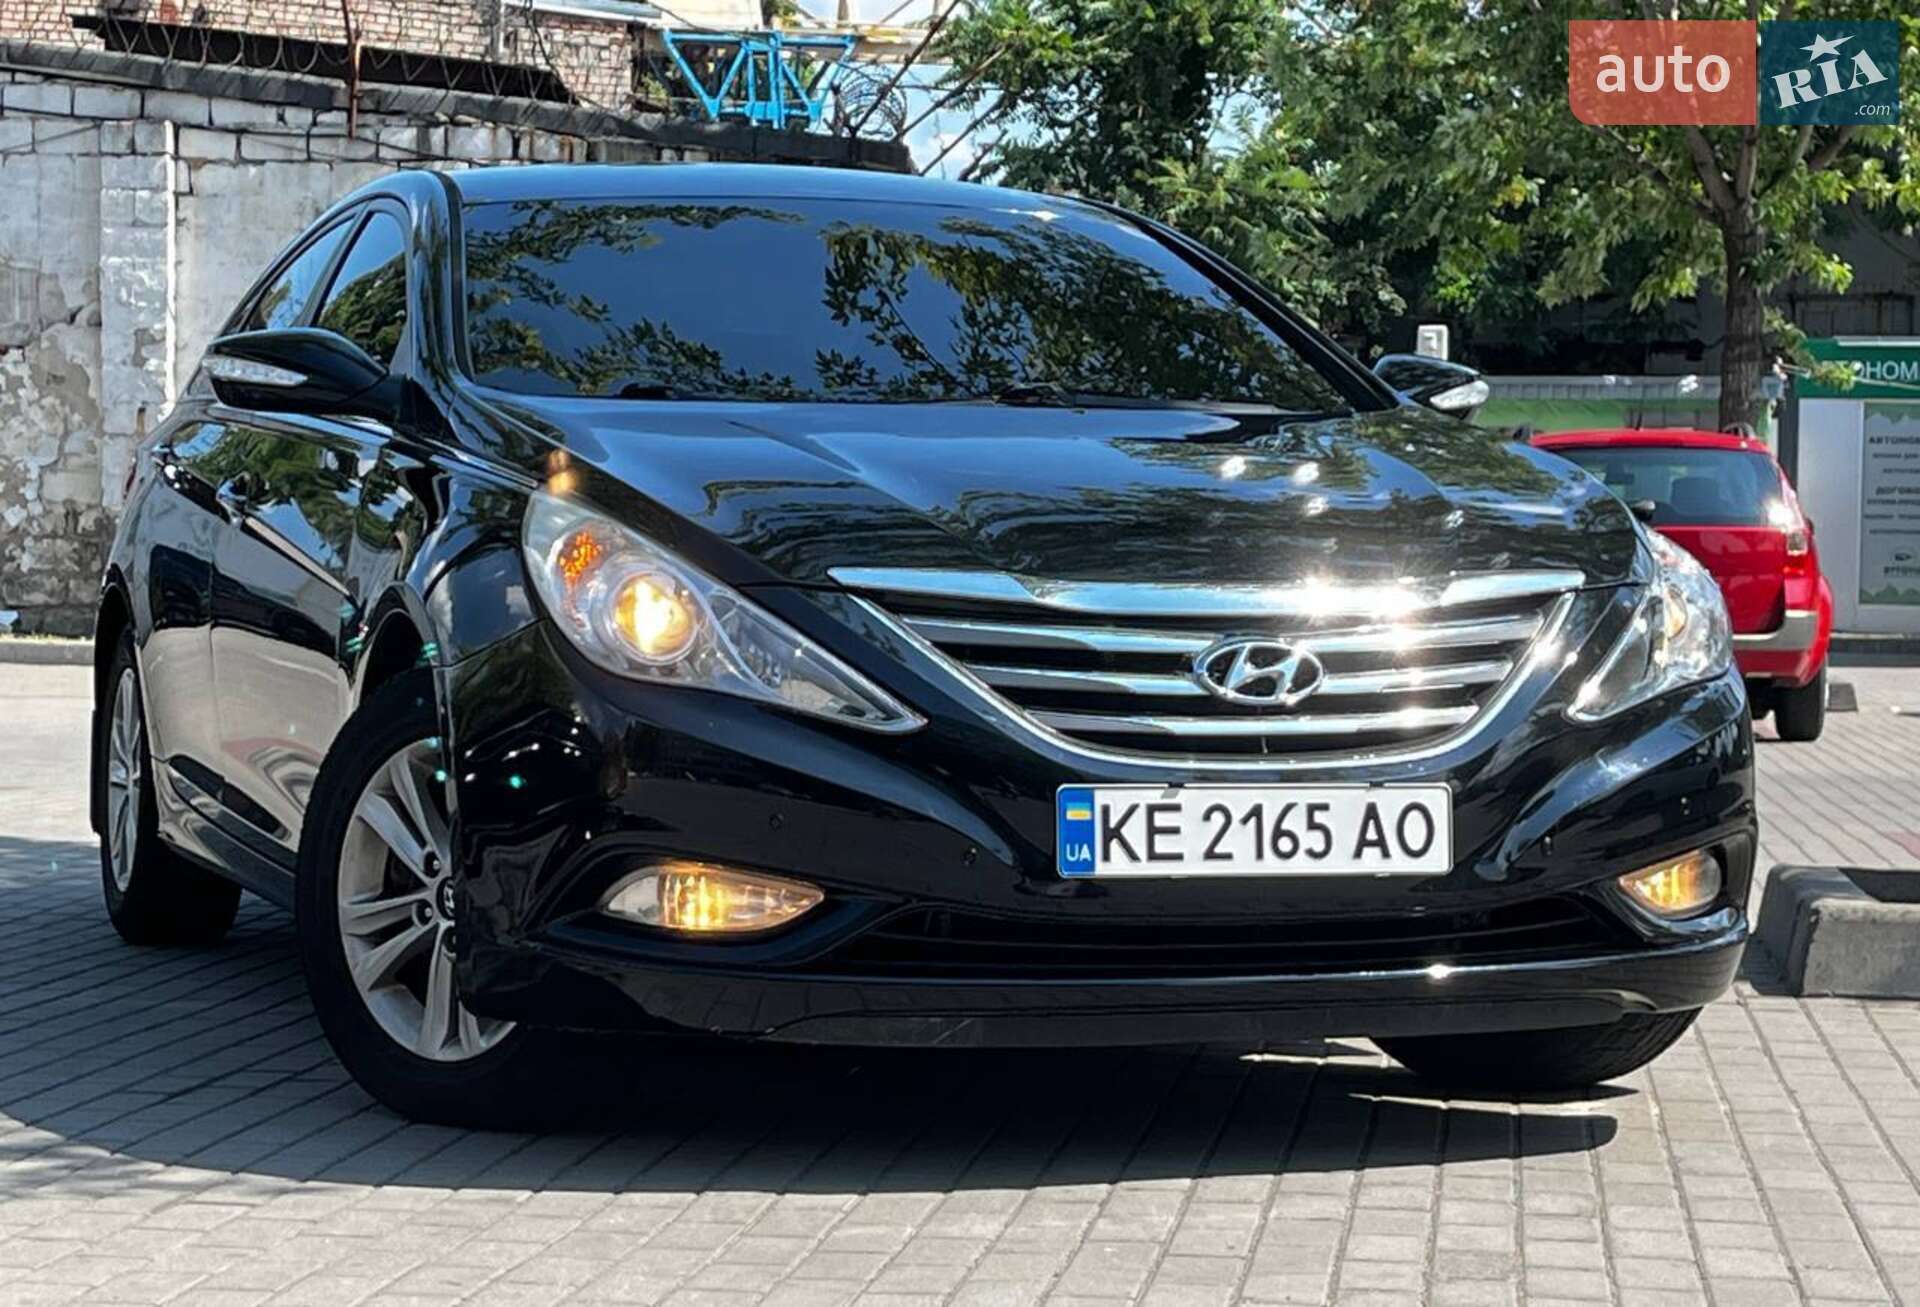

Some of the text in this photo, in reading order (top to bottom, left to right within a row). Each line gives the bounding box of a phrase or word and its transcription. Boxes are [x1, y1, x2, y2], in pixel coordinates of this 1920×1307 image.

[1101, 801, 1435, 862] KE 2165 AO
[1065, 844, 1092, 862] UA
